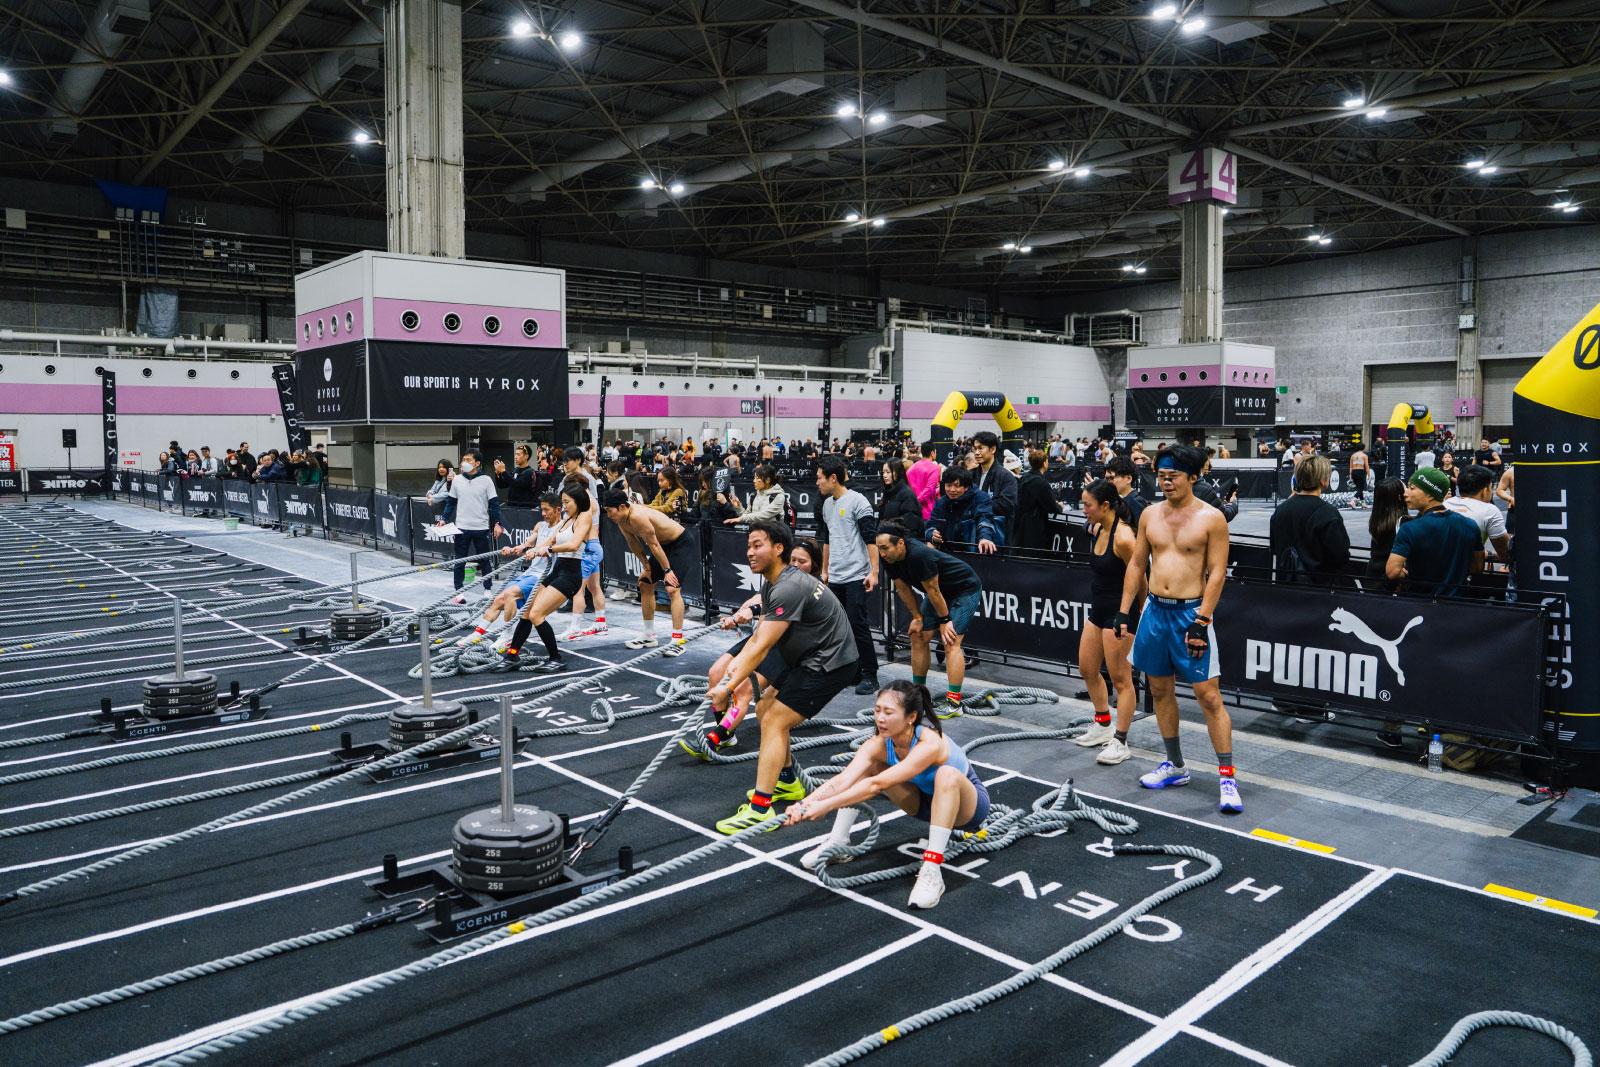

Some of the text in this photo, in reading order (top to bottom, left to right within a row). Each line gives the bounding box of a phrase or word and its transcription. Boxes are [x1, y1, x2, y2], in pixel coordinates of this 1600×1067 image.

[1180, 151, 1209, 193] 4
[1218, 153, 1235, 193] 4
[404, 375, 540, 391] OUR SPORT IS HYROX
[317, 387, 340, 400] HYROX
[278, 371, 301, 442] HYROX
[317, 404, 342, 413] OSAKA
[973, 397, 1000, 407] ROWING
[1235, 398, 1266, 408] HYROX
[1461, 406, 1468, 415] 5
[105, 379, 118, 457] HYROX
[1520, 442, 1588, 455] HYROX
[40, 479, 87, 489] NITRO
[1537, 489, 1570, 582] PULL
[1245, 638, 1379, 700] PUMA
[137, 726, 167, 736] CENTR
[399, 763, 429, 774] CENTR
[466, 910, 508, 927] CENTR
